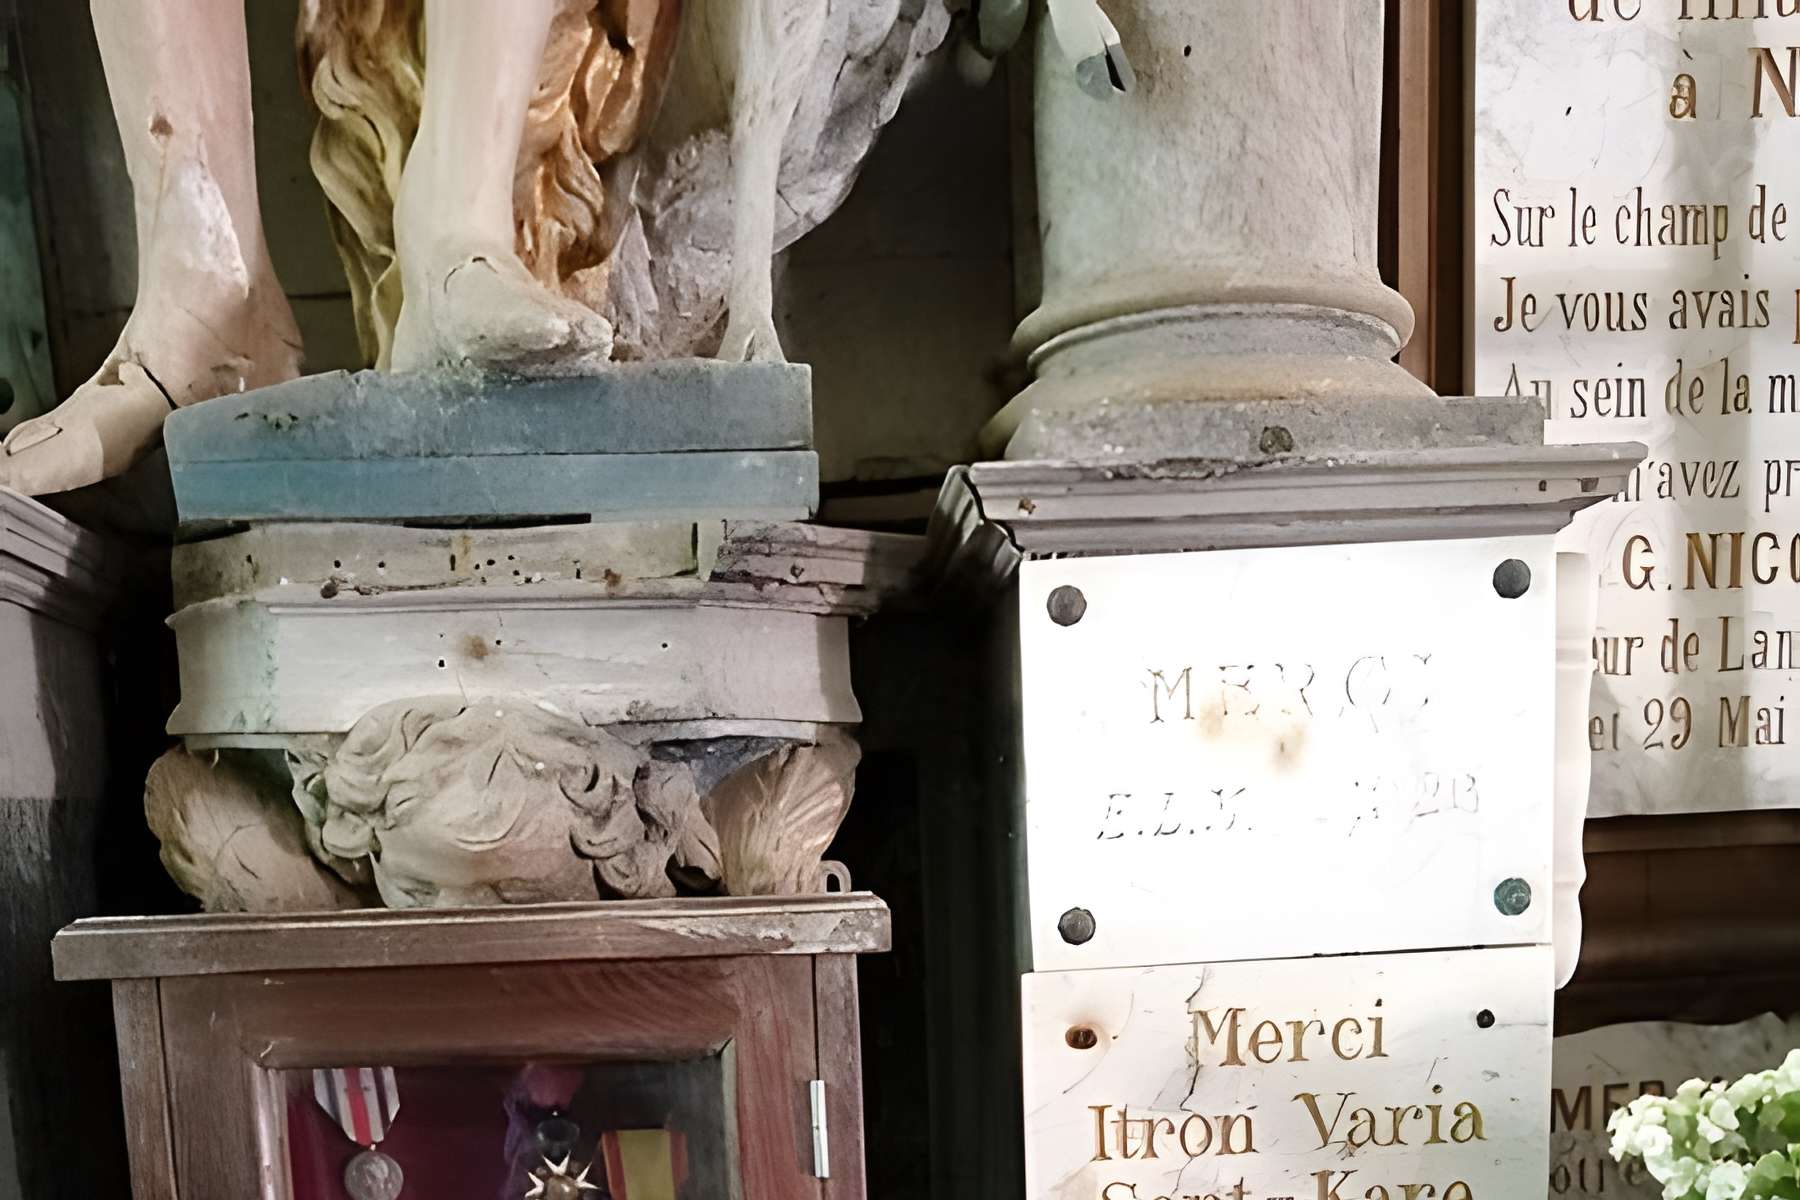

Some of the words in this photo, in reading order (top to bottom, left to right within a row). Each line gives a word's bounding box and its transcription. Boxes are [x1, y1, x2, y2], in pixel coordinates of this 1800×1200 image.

[1668, 49, 1698, 119] à
[1490, 188, 1556, 248] Sur
[1568, 187, 1597, 248] le
[1615, 187, 1729, 260] champ
[1748, 185, 1787, 243] de
[1493, 276, 1538, 332] Je
[1555, 291, 1648, 332] vous
[1668, 273, 1770, 330] avais
[1570, 361, 1647, 418] sein
[1664, 358, 1705, 416] de
[1720, 357, 1752, 415] la
[1660, 617, 1700, 674] de
[1643, 696, 1692, 750] 29
[1719, 695, 1786, 748] Mai
[1192, 999, 1390, 1067] Merci
[1088, 1103, 1259, 1163] Itron
[1293, 1084, 1486, 1149] Varia
